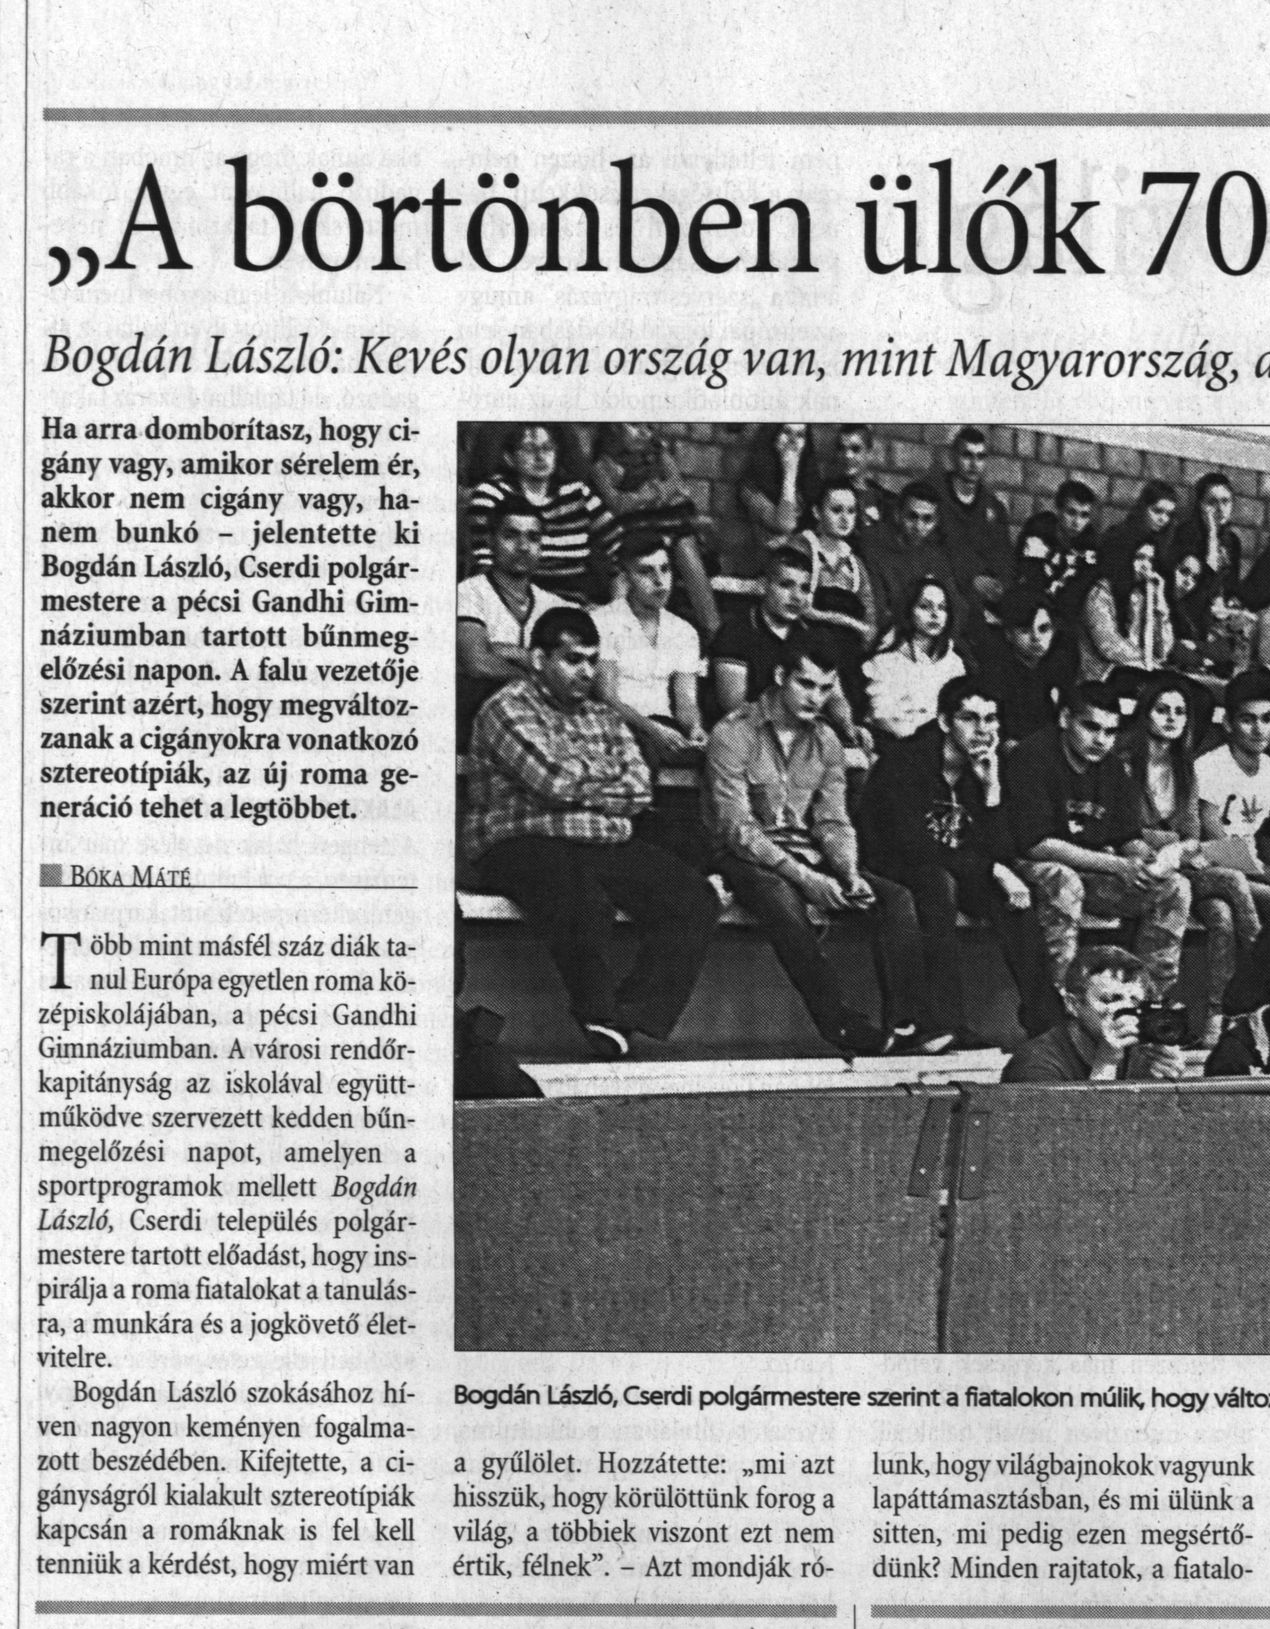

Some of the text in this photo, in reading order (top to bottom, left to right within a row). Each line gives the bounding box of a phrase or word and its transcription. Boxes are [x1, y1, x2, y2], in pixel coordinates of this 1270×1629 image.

[48, 163, 194, 288] „A
[224, 154, 820, 274] börtönben
[855, 158, 1106, 276] ülők
[1141, 170, 1268, 277] 70
[42, 331, 192, 387] Bogdán
[204, 332, 342, 374] László:
[354, 335, 468, 375] Kevés
[480, 333, 589, 389] olyan
[604, 336, 733, 390] ország
[743, 348, 825, 382] van,
[841, 336, 937, 377] mint
[945, 338, 1239, 392] Magyarország,
[41, 415, 420, 449] Ha arra domborítasz, hogy ci-
[41, 552, 419, 587] Bogdán László, Cserdi polgár-
[40, 690, 419, 724] szerint azért, hogy megváltoz-
[40, 724, 419, 758] zanak a cigányokra vonatkozó
[39, 793, 357, 827] neráció tehet a legtöbbet.
[70, 865, 192, 888] BÓKA MÁTÉ
[38, 1000, 417, 1033] zépiskolájában, a pécsi Gandhi
[38, 1069, 416, 1102] kapitányság az iskolával együtt-
[37, 1173, 417, 1206] sportprogramok mellett Bogdán
[37, 1207, 417, 1240] László, Cserdi település polgár-
[73, 1378, 416, 1410] Bogdán László szokásához hí-
[454, 1383, 541, 1410] Bogdán
[547, 1383, 619, 1409] László,
[622, 1384, 693, 1406] Cserdi
[699, 1384, 861, 1412] polgármestere
[867, 1386, 941, 1407] szerint
[945, 1391, 959, 1407] a
[964, 1385, 1074, 1408] fiatalokon
[1080, 1385, 1145, 1411] múlik,
[1151, 1386, 1210, 1414] hogy
[454, 1449, 835, 1481] a gyűlölet. Hozzátette: „mi azt
[36, 1481, 416, 1514] gányságról kialakult sztereotípiák
[453, 1483, 835, 1517] hisszük, hogy körülöttünk forog a
[872, 1485, 1255, 1517] lapáttámasztásban, és mi ülünk a
[872, 1520, 1253, 1553] sitten, mi pedig ezen megsértő-
